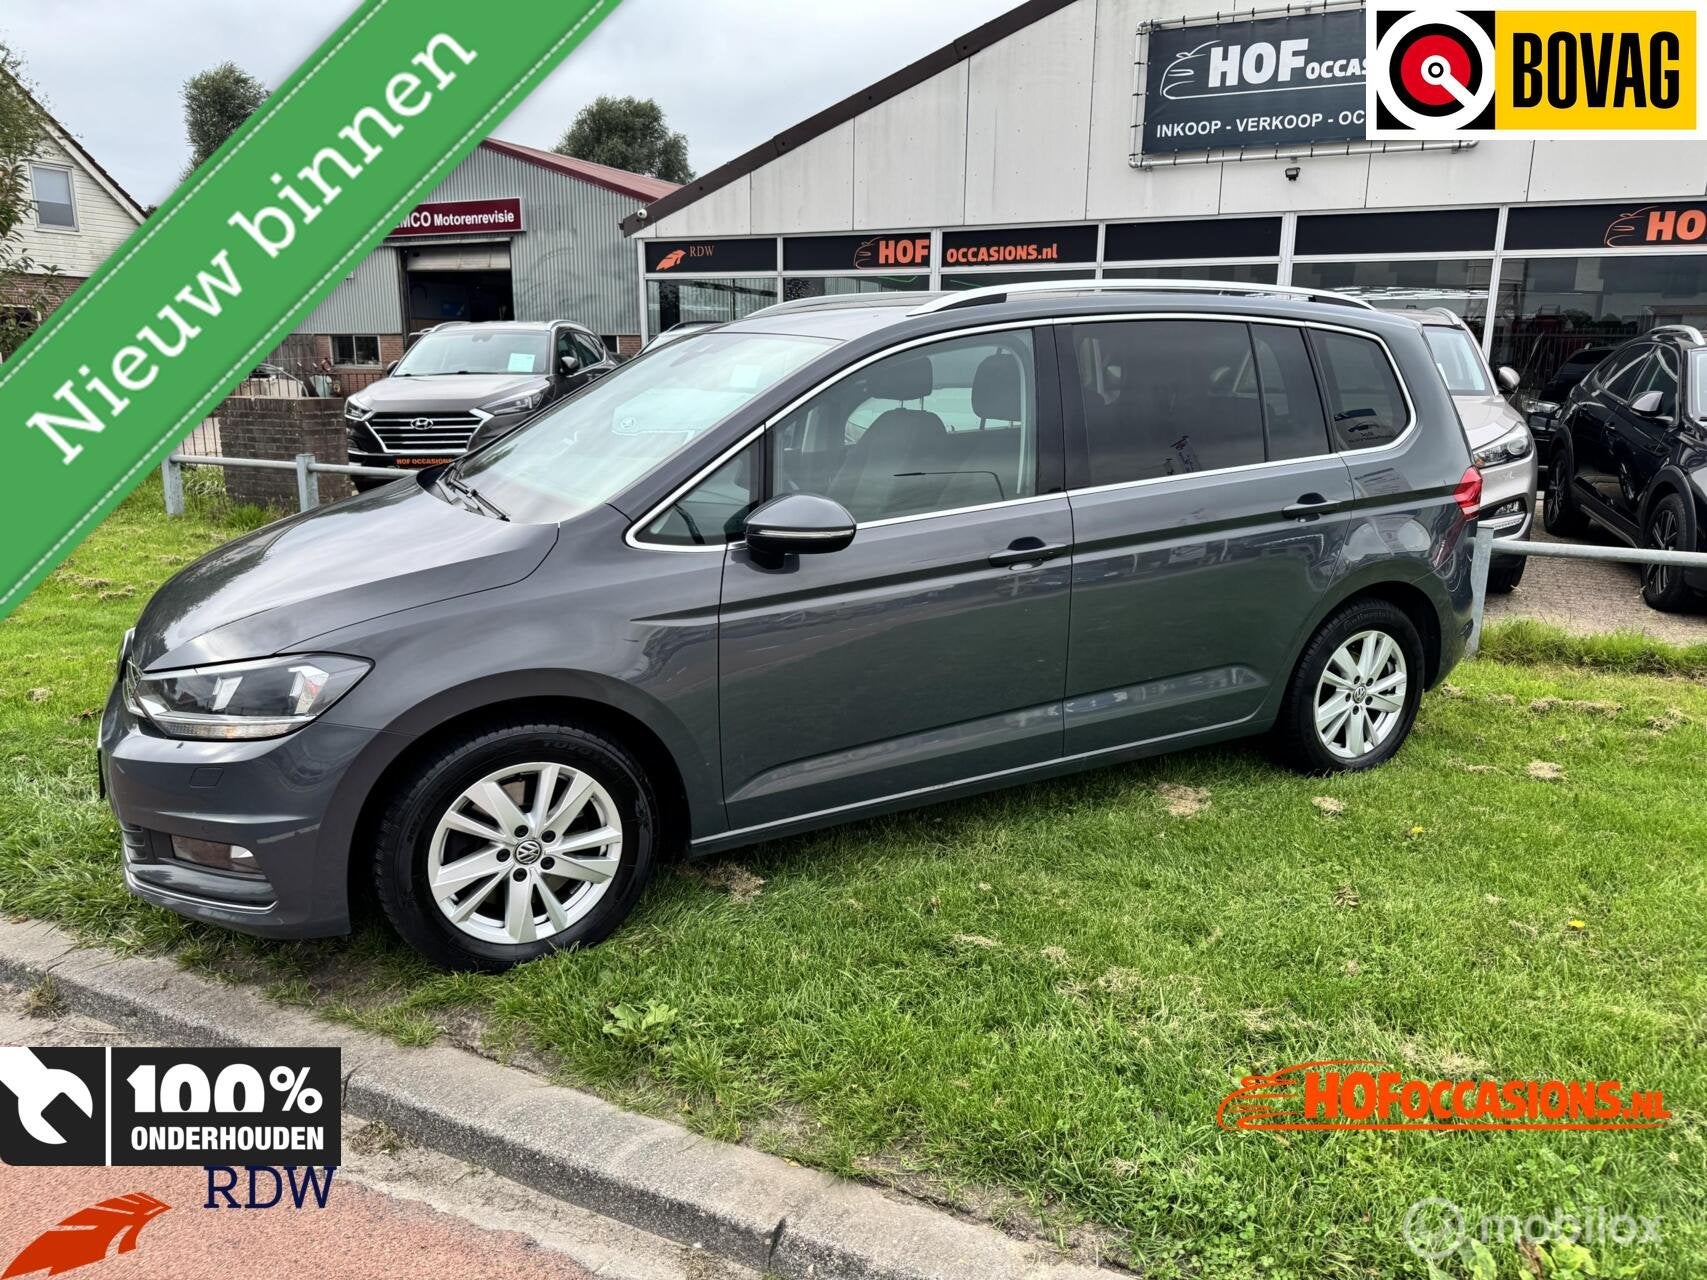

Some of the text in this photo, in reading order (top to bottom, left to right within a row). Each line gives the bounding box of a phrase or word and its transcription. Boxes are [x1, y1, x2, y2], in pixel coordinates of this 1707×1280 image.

[1157, 120, 1221, 138] INKOOP
[1236, 113, 1323, 132] VERKOOP
[397, 210, 515, 228] MCO Motorenrevisie
[690, 245, 714, 257] RDW
[878, 239, 1058, 264] HOF OCCASIONS.nl
